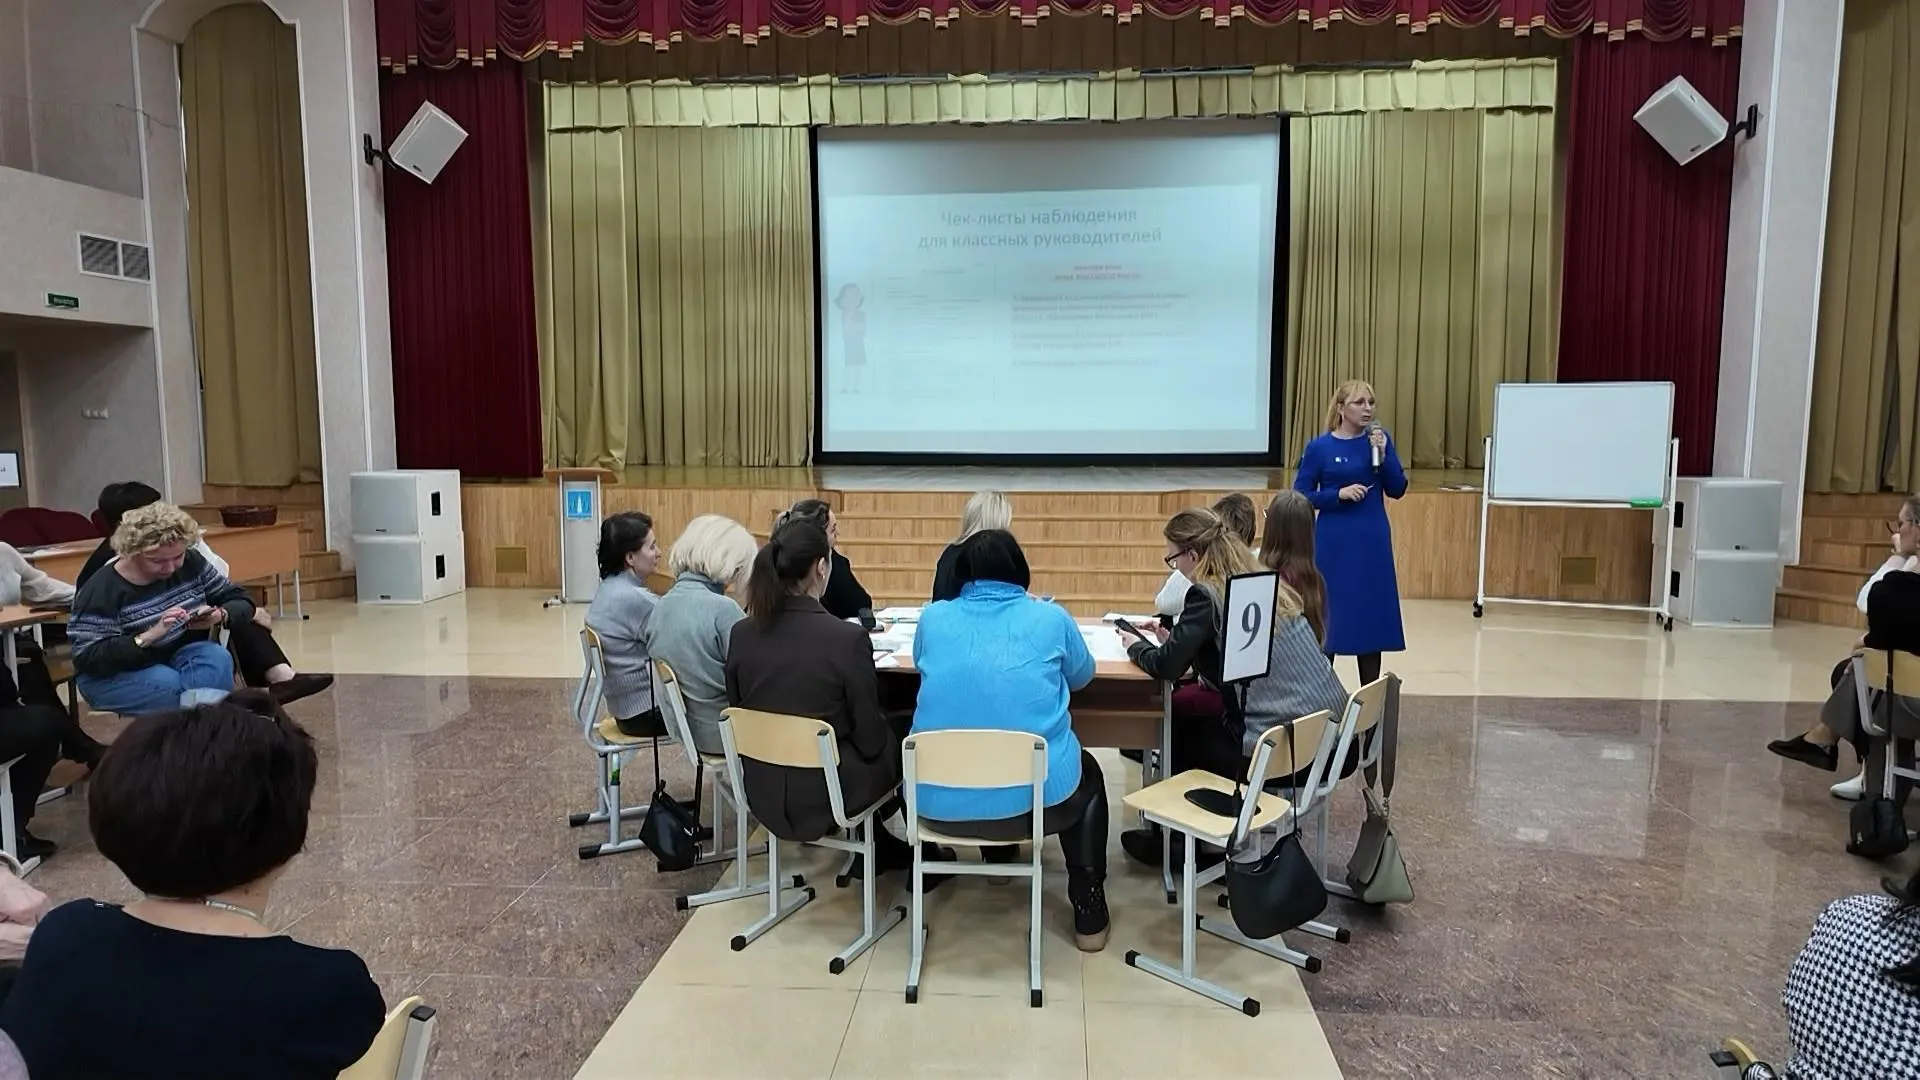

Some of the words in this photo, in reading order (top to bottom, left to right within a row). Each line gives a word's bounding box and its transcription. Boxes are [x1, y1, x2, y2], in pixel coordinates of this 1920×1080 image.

[941, 211, 1025, 226] Чек-листы
[1031, 208, 1137, 226] наблюдения
[918, 235, 947, 251] для
[952, 232, 1029, 248] классных
[1034, 226, 1161, 248] руководителей
[1239, 602, 1261, 652] 9
